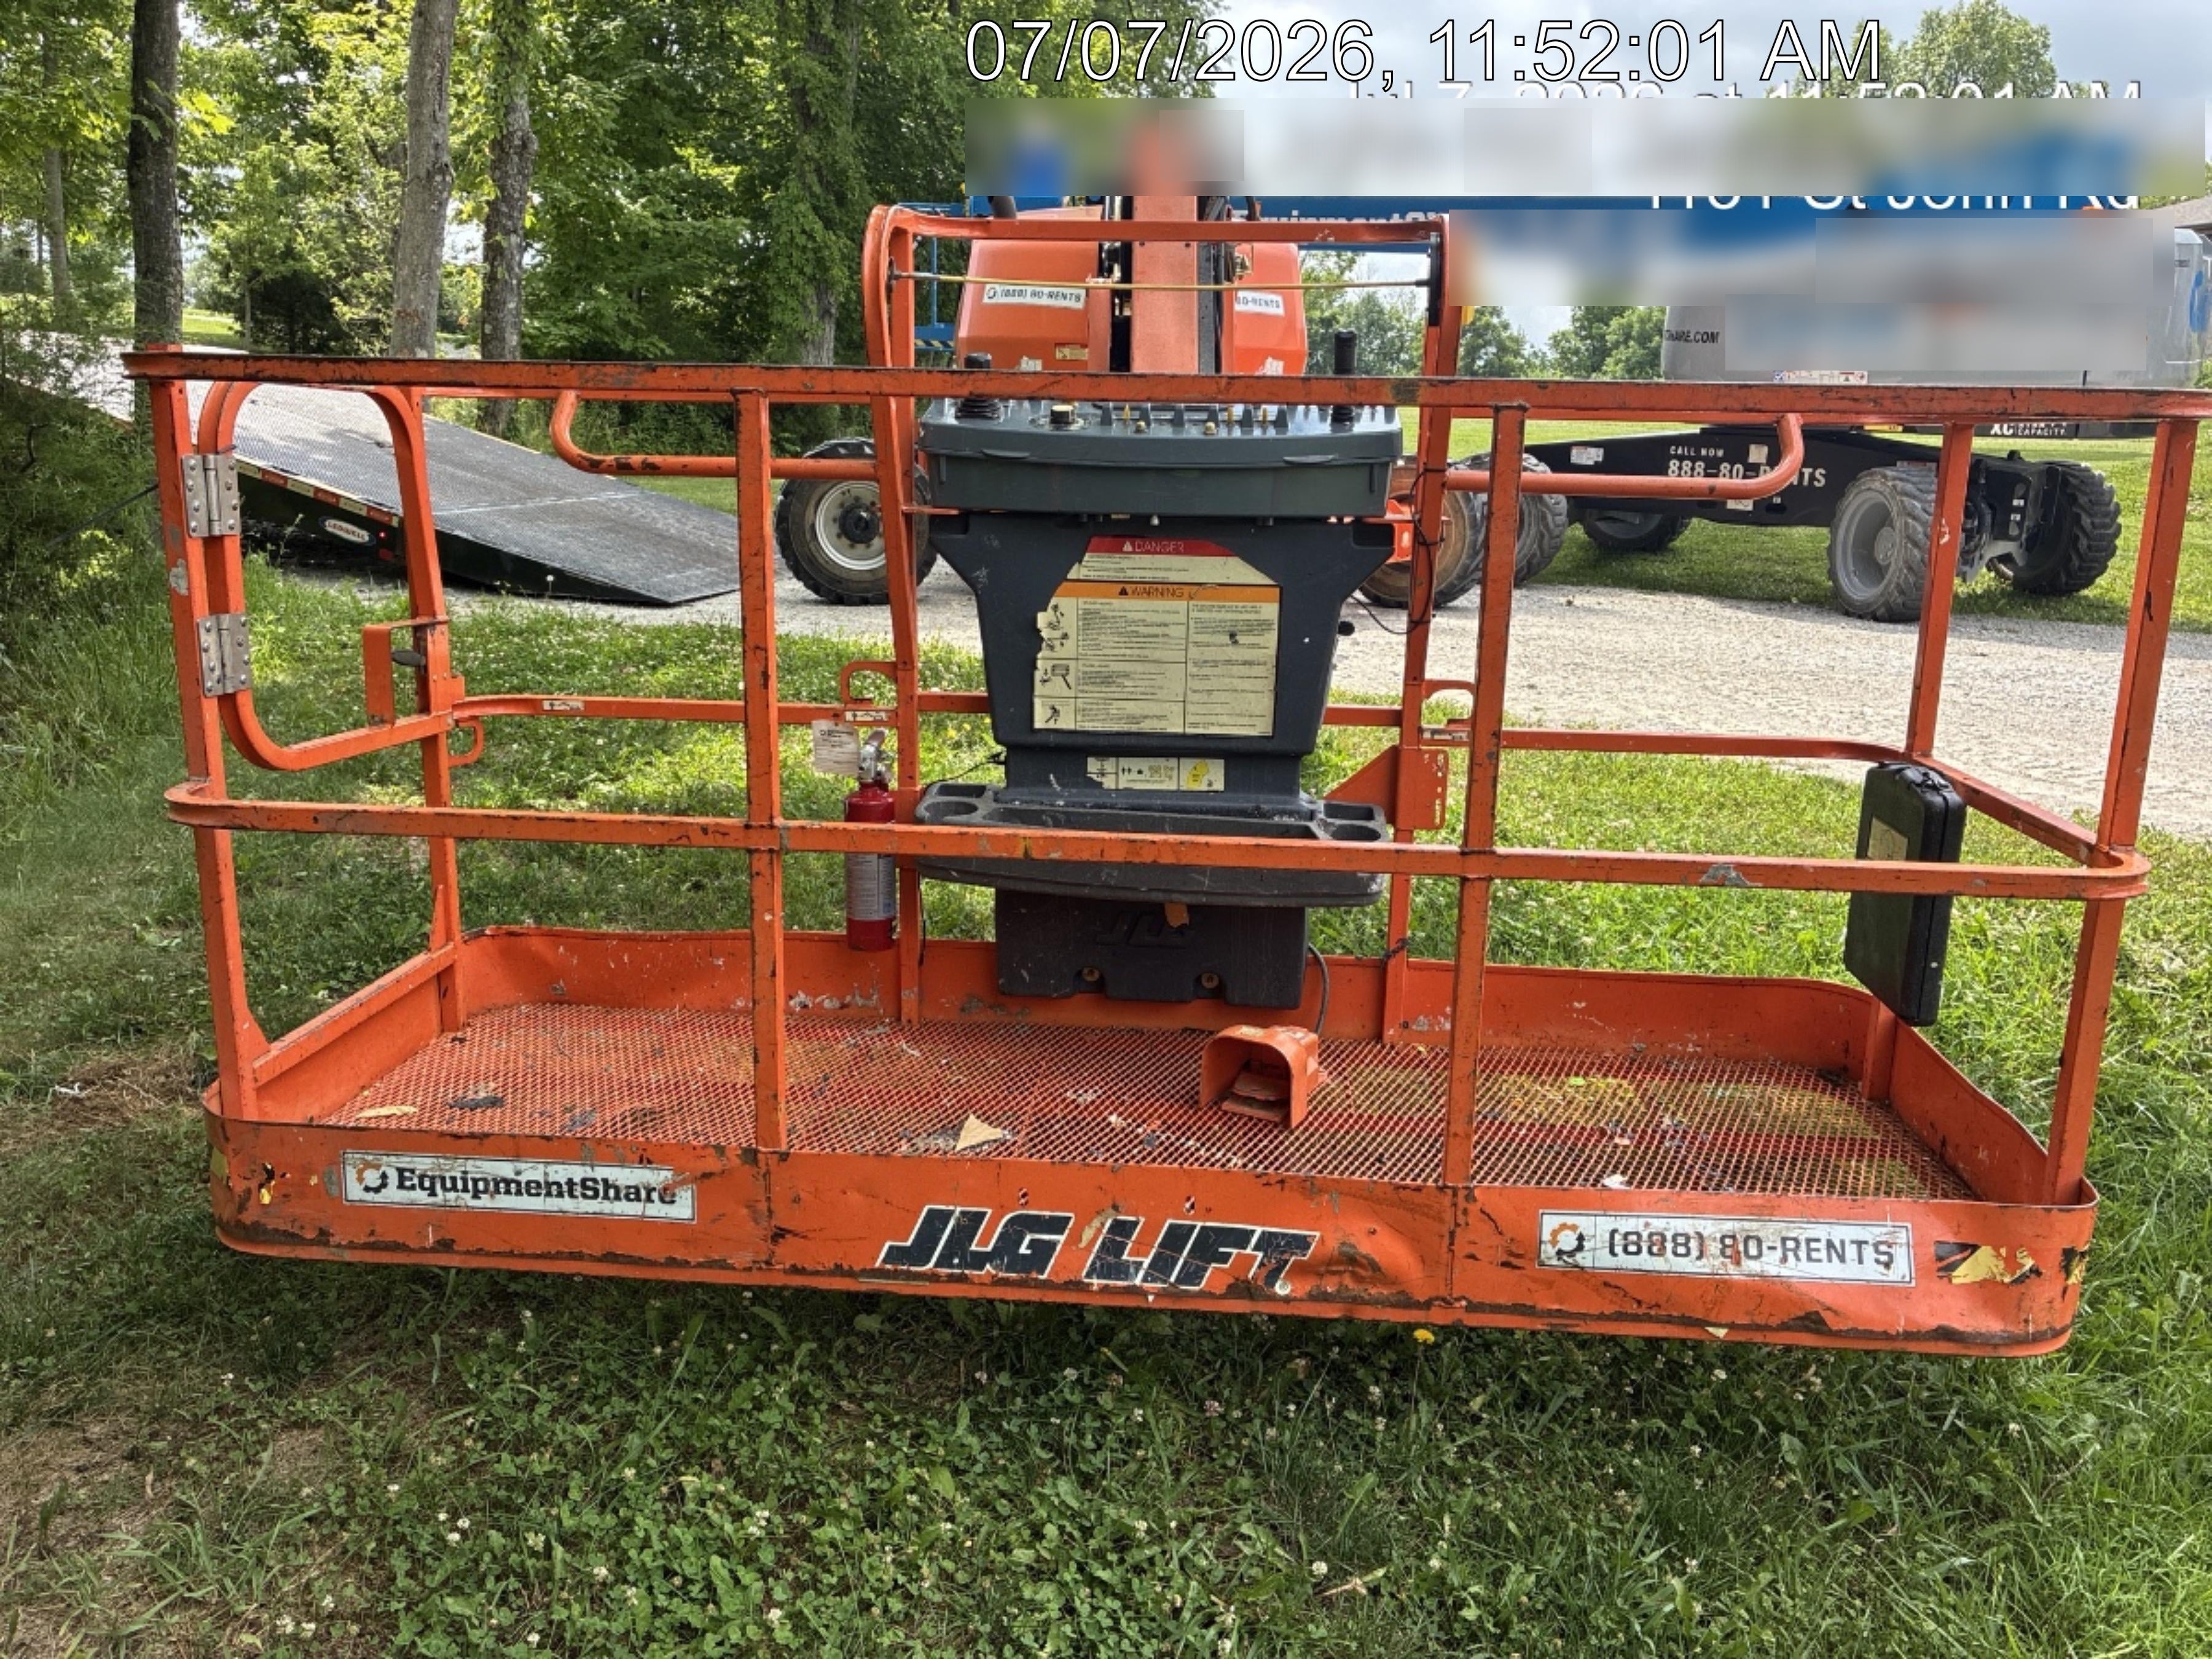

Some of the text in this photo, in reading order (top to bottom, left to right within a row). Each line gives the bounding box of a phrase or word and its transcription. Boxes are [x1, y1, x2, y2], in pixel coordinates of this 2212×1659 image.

[1669, 445, 1725, 458] CALL NOW
[1134, 541, 1184, 552] DANGER
[1131, 586, 1184, 597] WARNING
[395, 1167, 678, 1205] EquipmentShare
[875, 1204, 1320, 1295] JLG LIFT
[1608, 1227, 1896, 1268] (888) 80-RENTS
